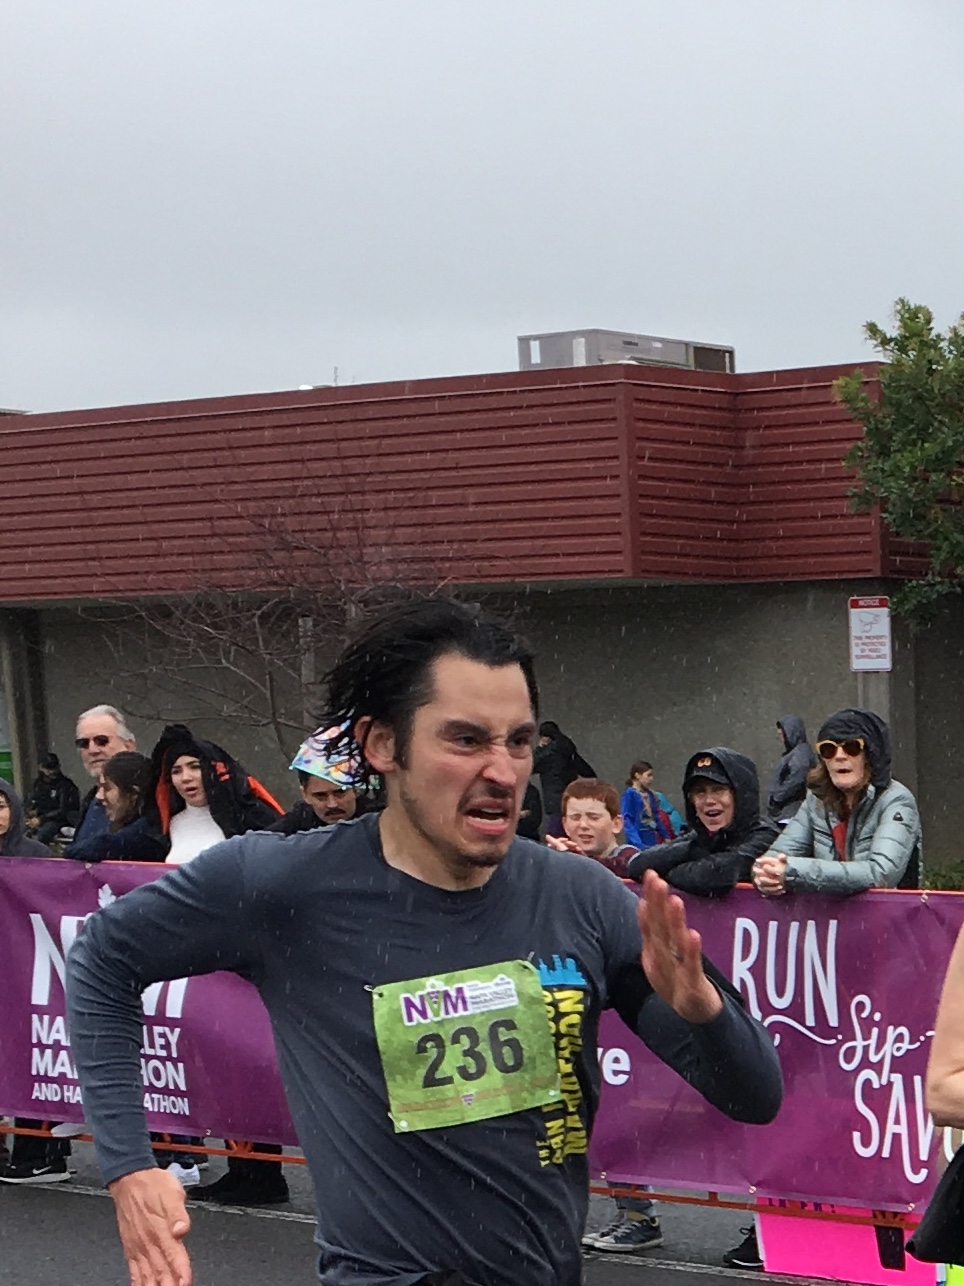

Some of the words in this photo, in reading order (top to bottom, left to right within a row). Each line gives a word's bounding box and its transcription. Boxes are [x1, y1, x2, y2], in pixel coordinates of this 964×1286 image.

[732, 917, 838, 1028] RUN
[31, 1014, 71, 1047] NA
[415, 1019, 524, 1089] 236
[838, 994, 920, 1086] Sip
[31, 1082, 62, 1102] AND
[63, 1085, 84, 1105] HA
